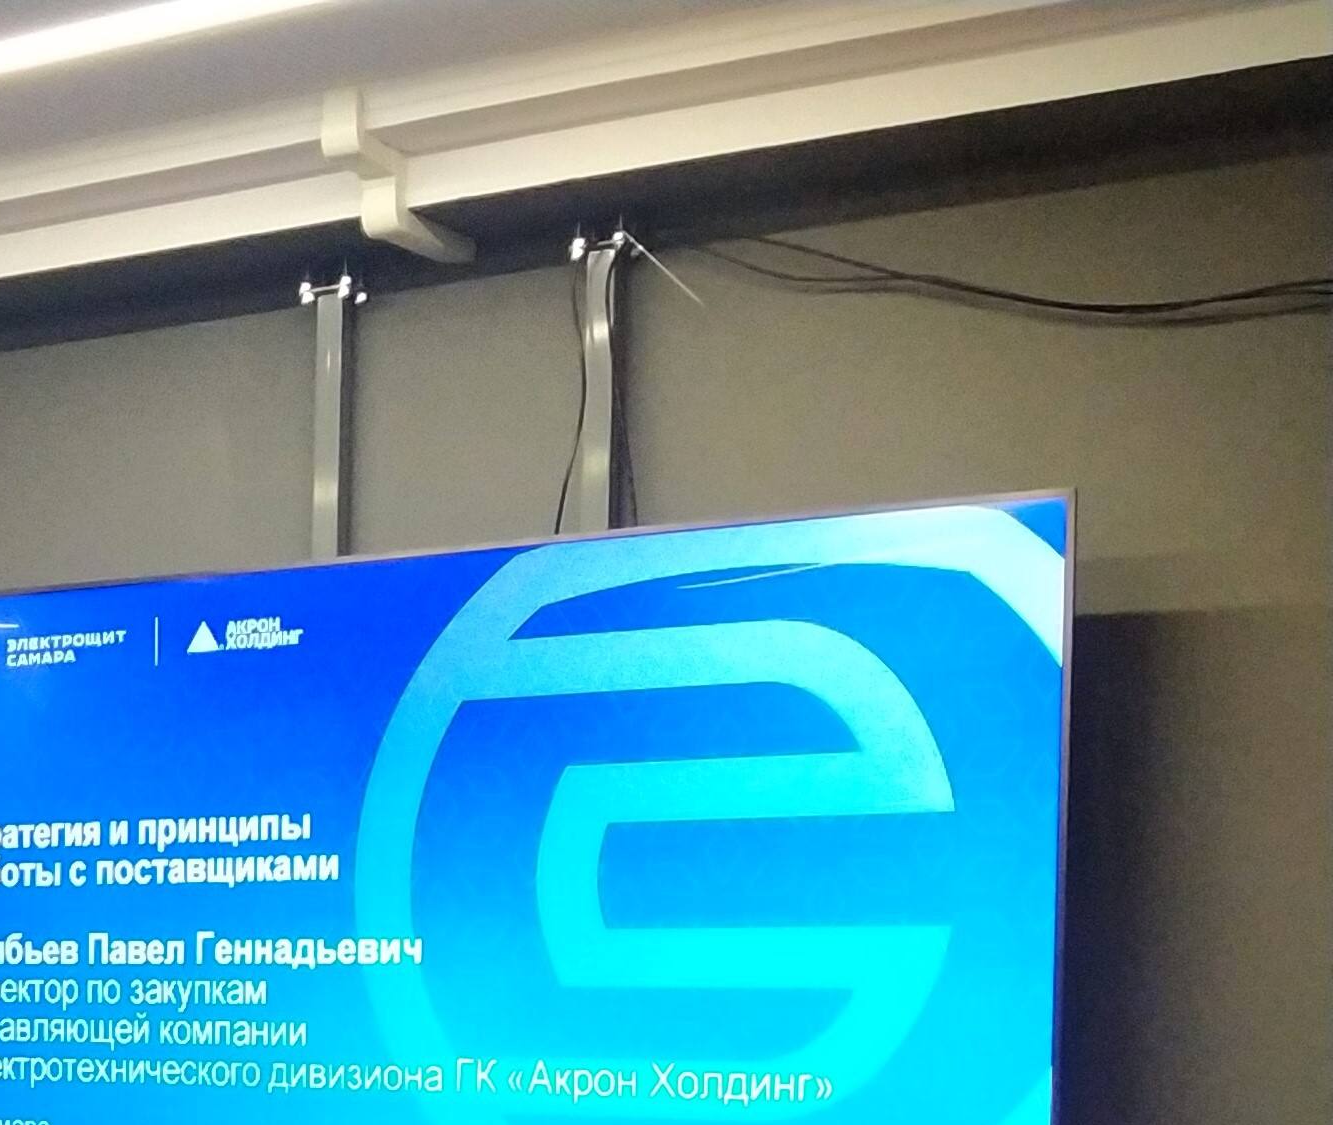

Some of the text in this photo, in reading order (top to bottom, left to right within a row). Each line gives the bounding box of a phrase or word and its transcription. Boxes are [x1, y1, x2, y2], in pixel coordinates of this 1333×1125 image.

[6, 629, 127, 653] ЭЛЕКТРОЩИТ
[225, 629, 304, 651] ХОЛДИНГ
[226, 616, 281, 635] АКРОН
[6, 650, 76, 668] САМАРА
[110, 821, 129, 847] и
[138, 813, 312, 853] принципы
[68, 860, 87, 887] с
[96, 854, 340, 889] поставщиками
[88, 932, 185, 966] Павел
[196, 931, 423, 969] Геннадьевич
[86, 978, 121, 1003] по
[130, 977, 268, 1012] закупкам
[159, 1017, 307, 1047] компании
[268, 1061, 444, 1094] дивизиона
[455, 1057, 498, 1092] ГК
[508, 1060, 637, 1104] «Акрон
[649, 1062, 833, 1107] Холдинг»
